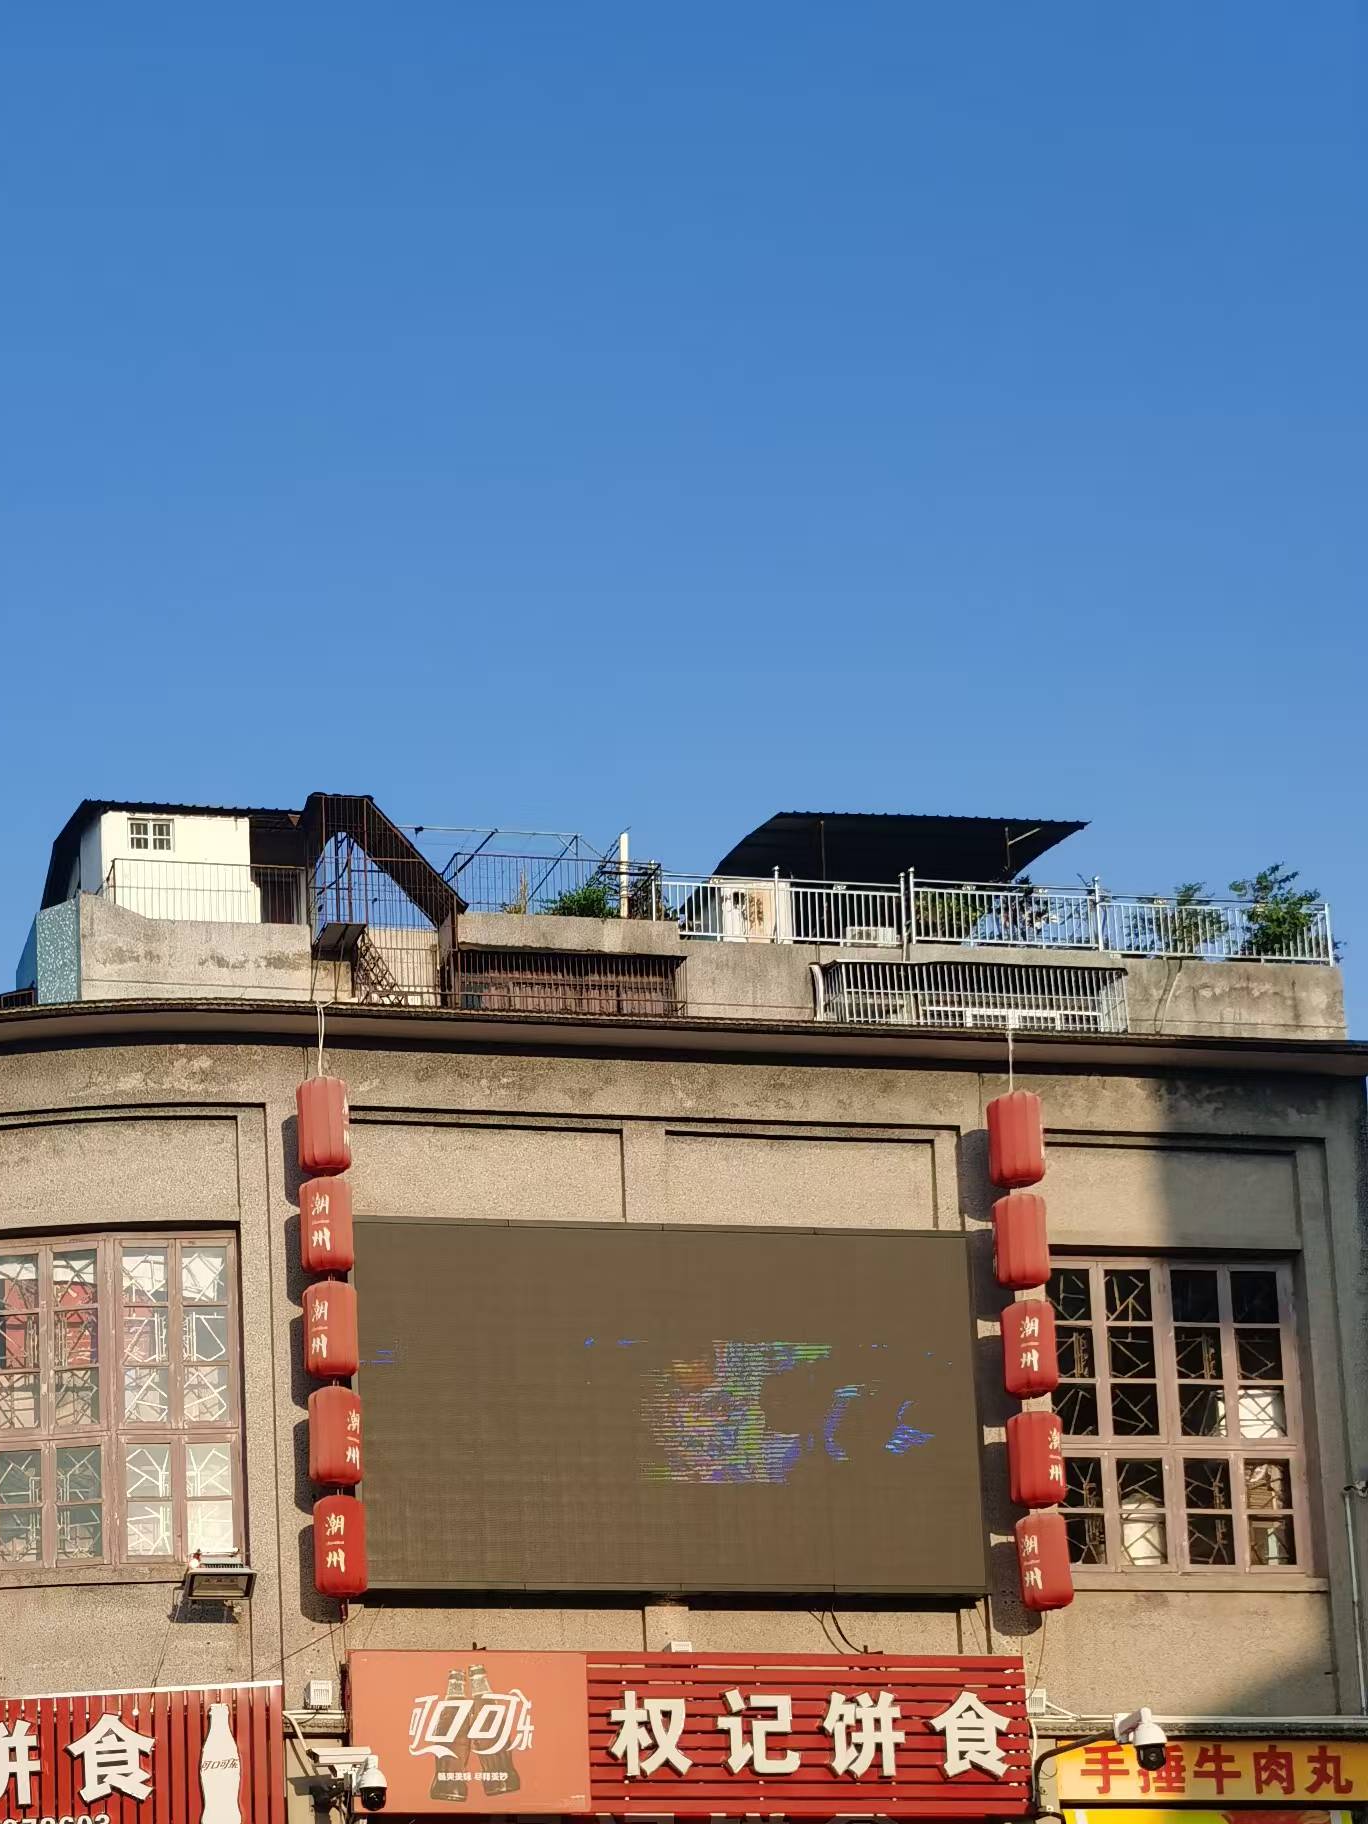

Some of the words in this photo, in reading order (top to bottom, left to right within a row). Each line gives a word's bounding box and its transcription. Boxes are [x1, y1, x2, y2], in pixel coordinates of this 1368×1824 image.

[312, 1193, 330, 1251] 潮州
[311, 1299, 329, 1358] 潮州
[1020, 1316, 1039, 1371] 潮州
[325, 1512, 345, 1573] 潮州
[1023, 1534, 1043, 1590] 潮州
[407, 1689, 535, 1758] 可口可乐
[609, 1688, 1011, 1779] 权记饼食
